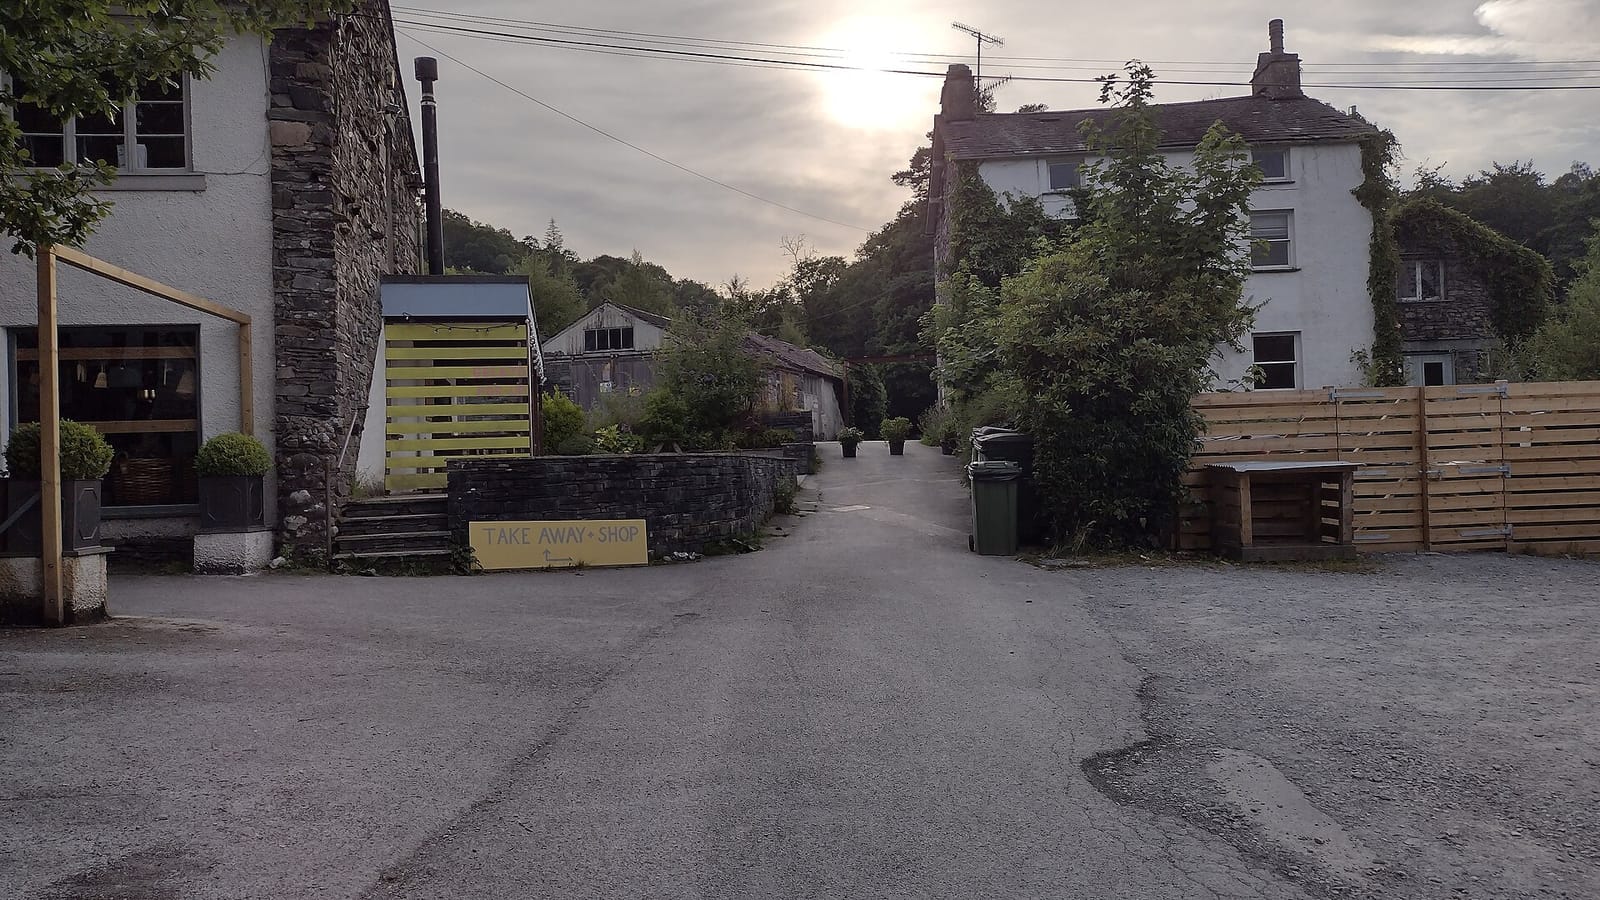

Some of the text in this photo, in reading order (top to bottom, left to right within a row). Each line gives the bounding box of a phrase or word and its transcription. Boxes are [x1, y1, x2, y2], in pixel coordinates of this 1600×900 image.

[482, 527, 531, 545] TAKE
[538, 526, 586, 545] AWAY
[598, 525, 640, 543] SHOP
